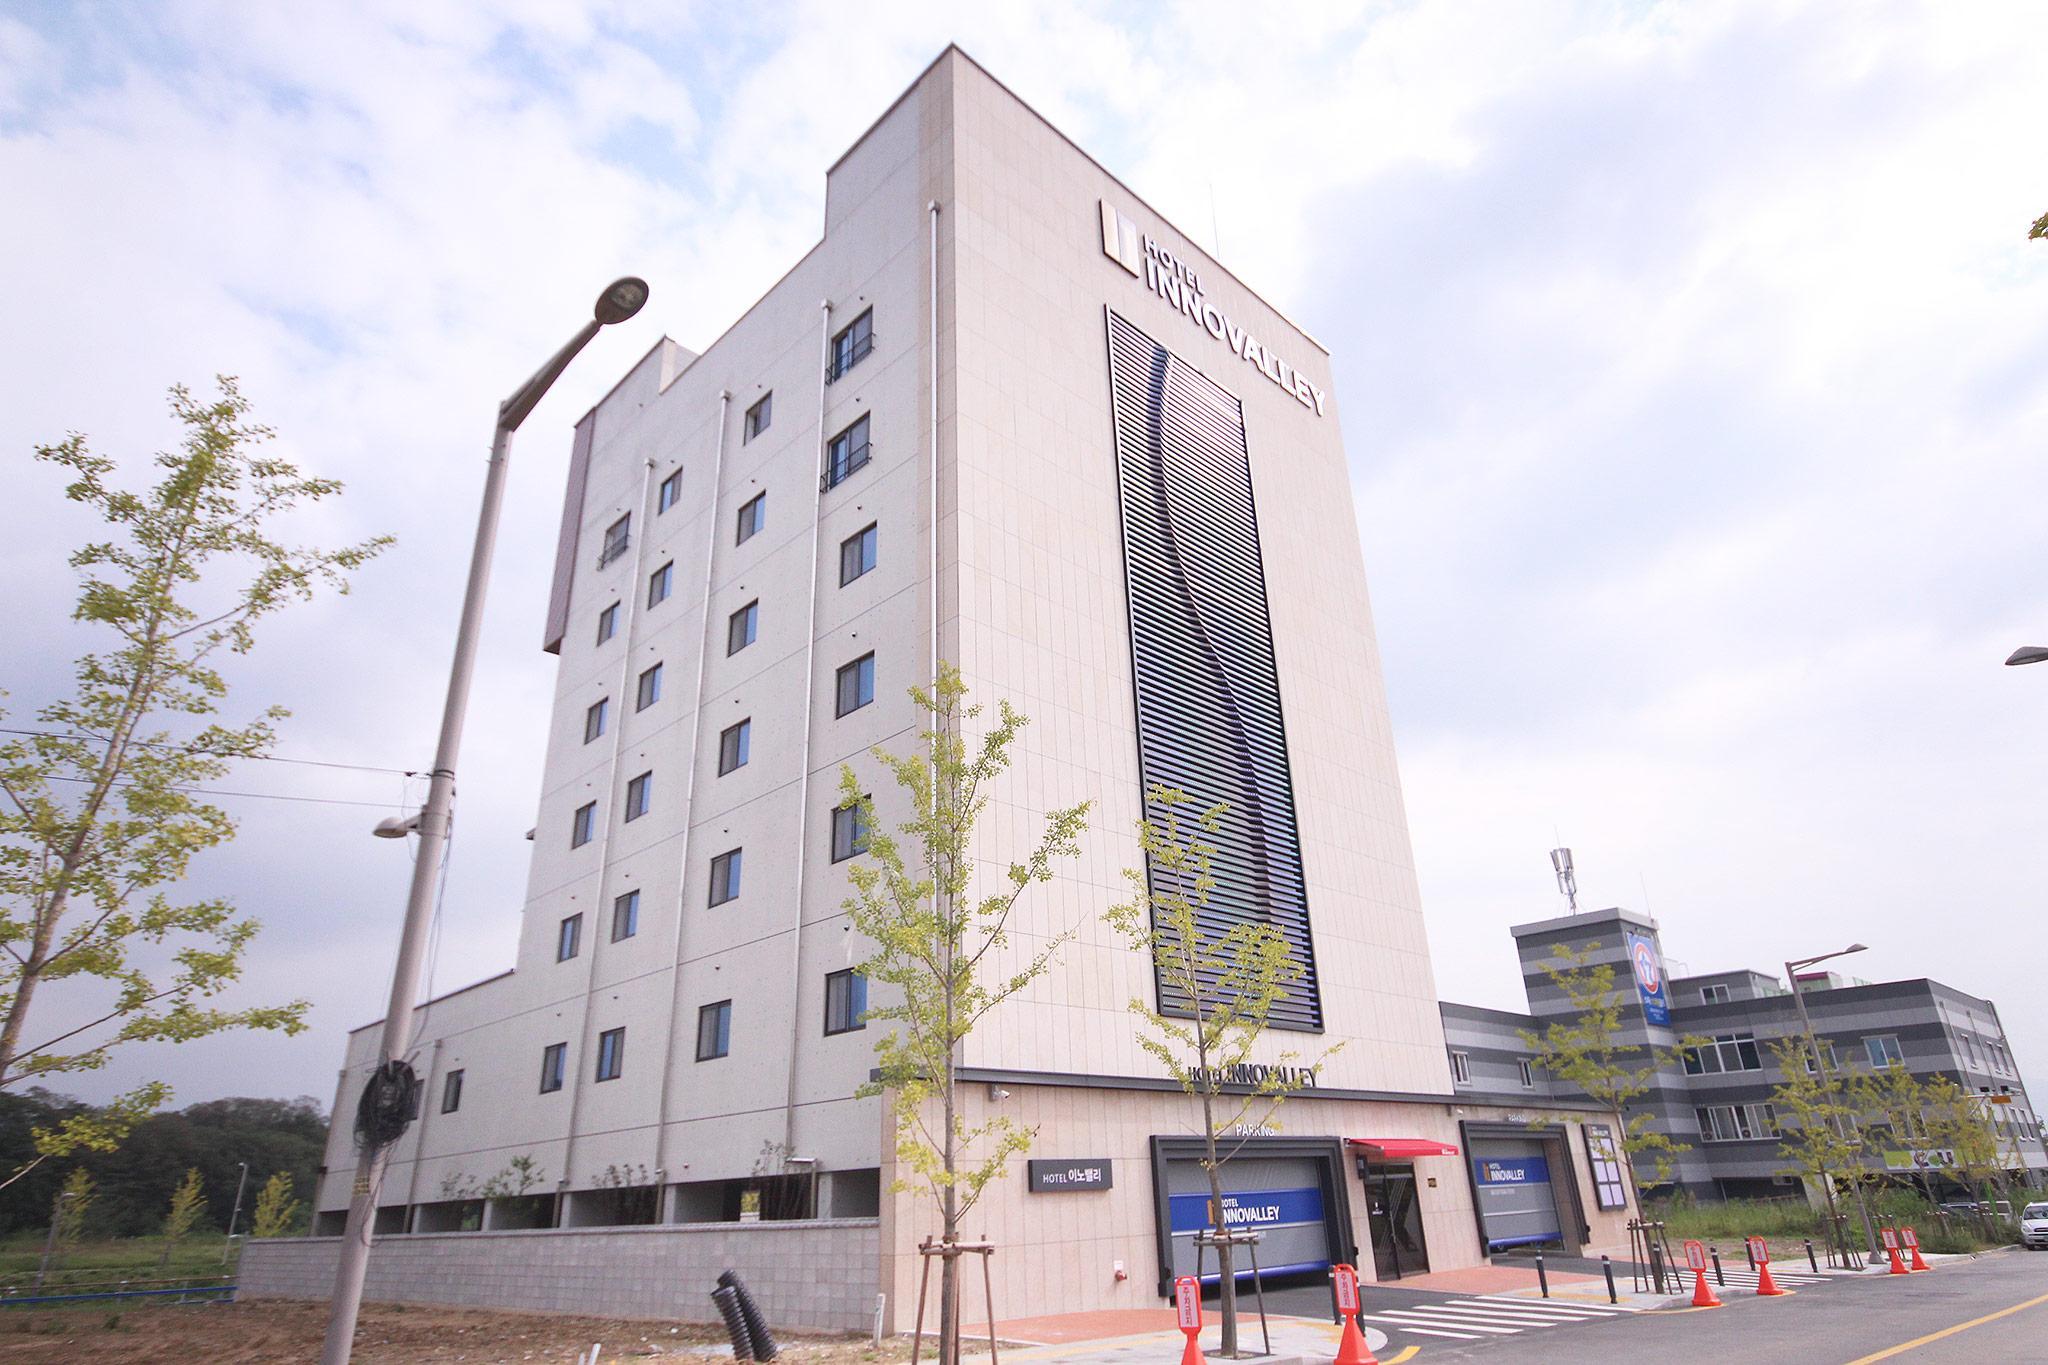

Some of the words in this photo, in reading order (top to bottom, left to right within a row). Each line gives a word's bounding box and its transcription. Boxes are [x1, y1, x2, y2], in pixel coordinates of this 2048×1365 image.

[1143, 233, 1205, 296] HOTEL
[1145, 256, 1326, 417] INNOVALLEY
[1043, 1173, 1067, 1183] HOTEL
[1490, 1169, 1525, 1181] INNOVALLEY
[1223, 1206, 1280, 1224] NNOVALLEY
